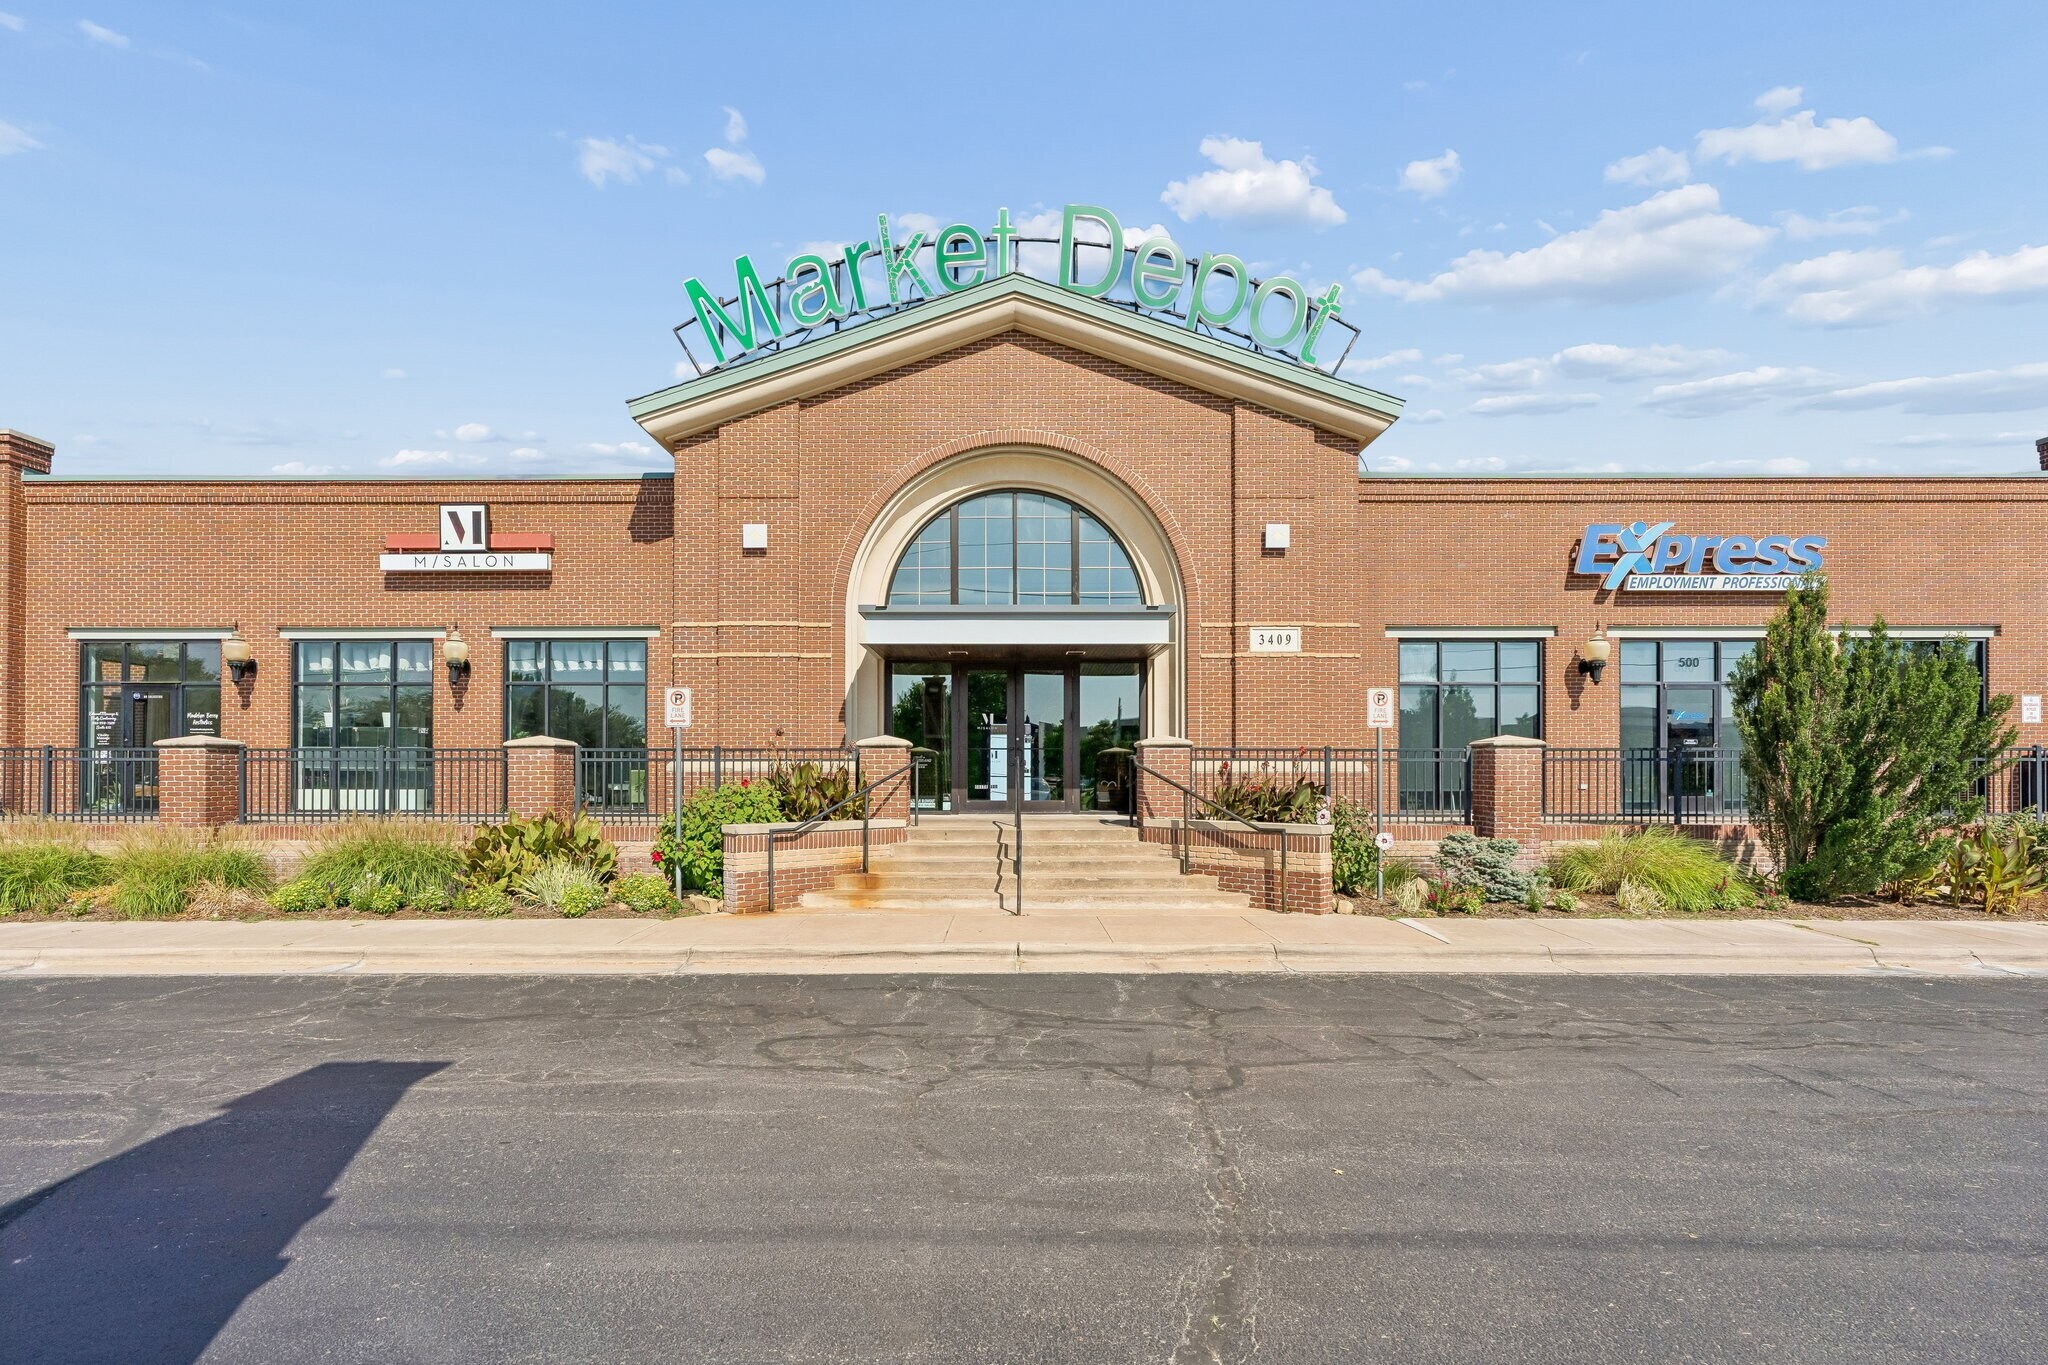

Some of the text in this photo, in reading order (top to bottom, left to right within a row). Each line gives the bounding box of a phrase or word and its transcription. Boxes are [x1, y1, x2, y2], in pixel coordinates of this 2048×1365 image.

[683, 203, 1342, 368] Market Depot
[414, 555, 514, 568] M/SALON
[1574, 521, 1828, 590] Express
[1629, 576, 1717, 589] EMPLOYMENT
[1258, 633, 1292, 646] 3409
[1678, 657, 1700, 668] 500
